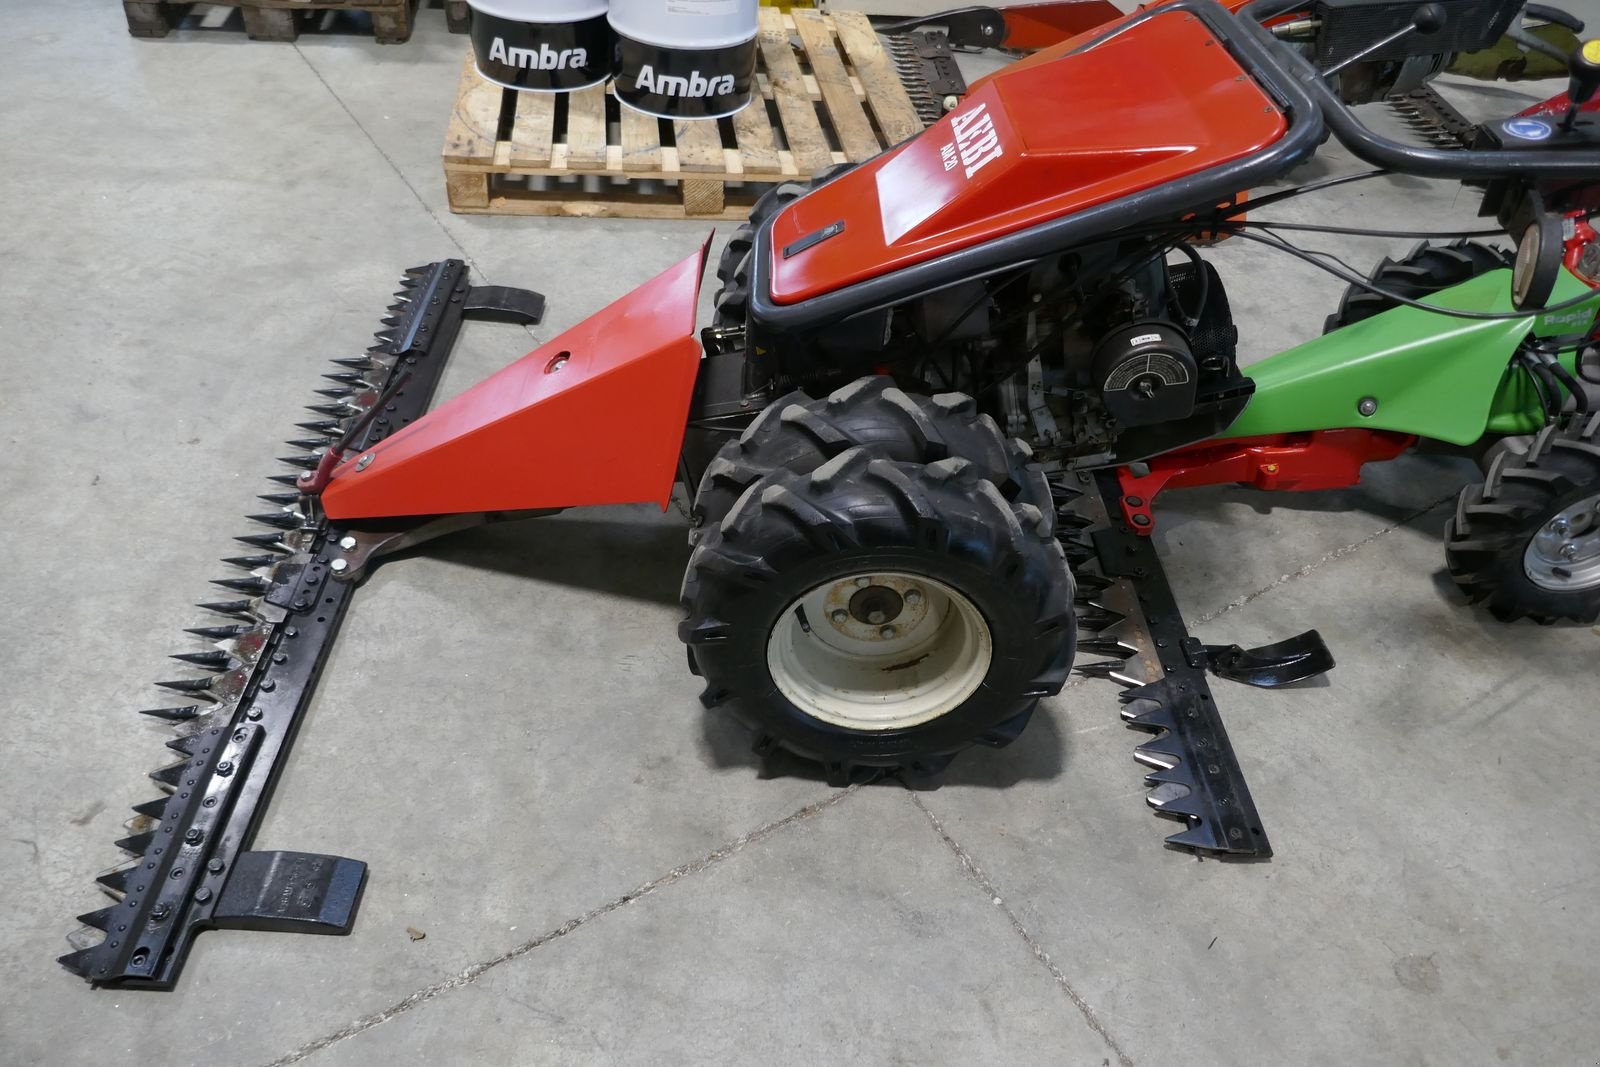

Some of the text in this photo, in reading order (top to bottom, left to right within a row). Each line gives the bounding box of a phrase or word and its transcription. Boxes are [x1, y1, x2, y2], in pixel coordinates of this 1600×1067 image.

[489, 37, 587, 70] Ambra
[635, 65, 735, 98] Ambra
[940, 142, 959, 171] AM 20
[951, 103, 1003, 179] AEBI
[1544, 308, 1592, 326] Rapid
